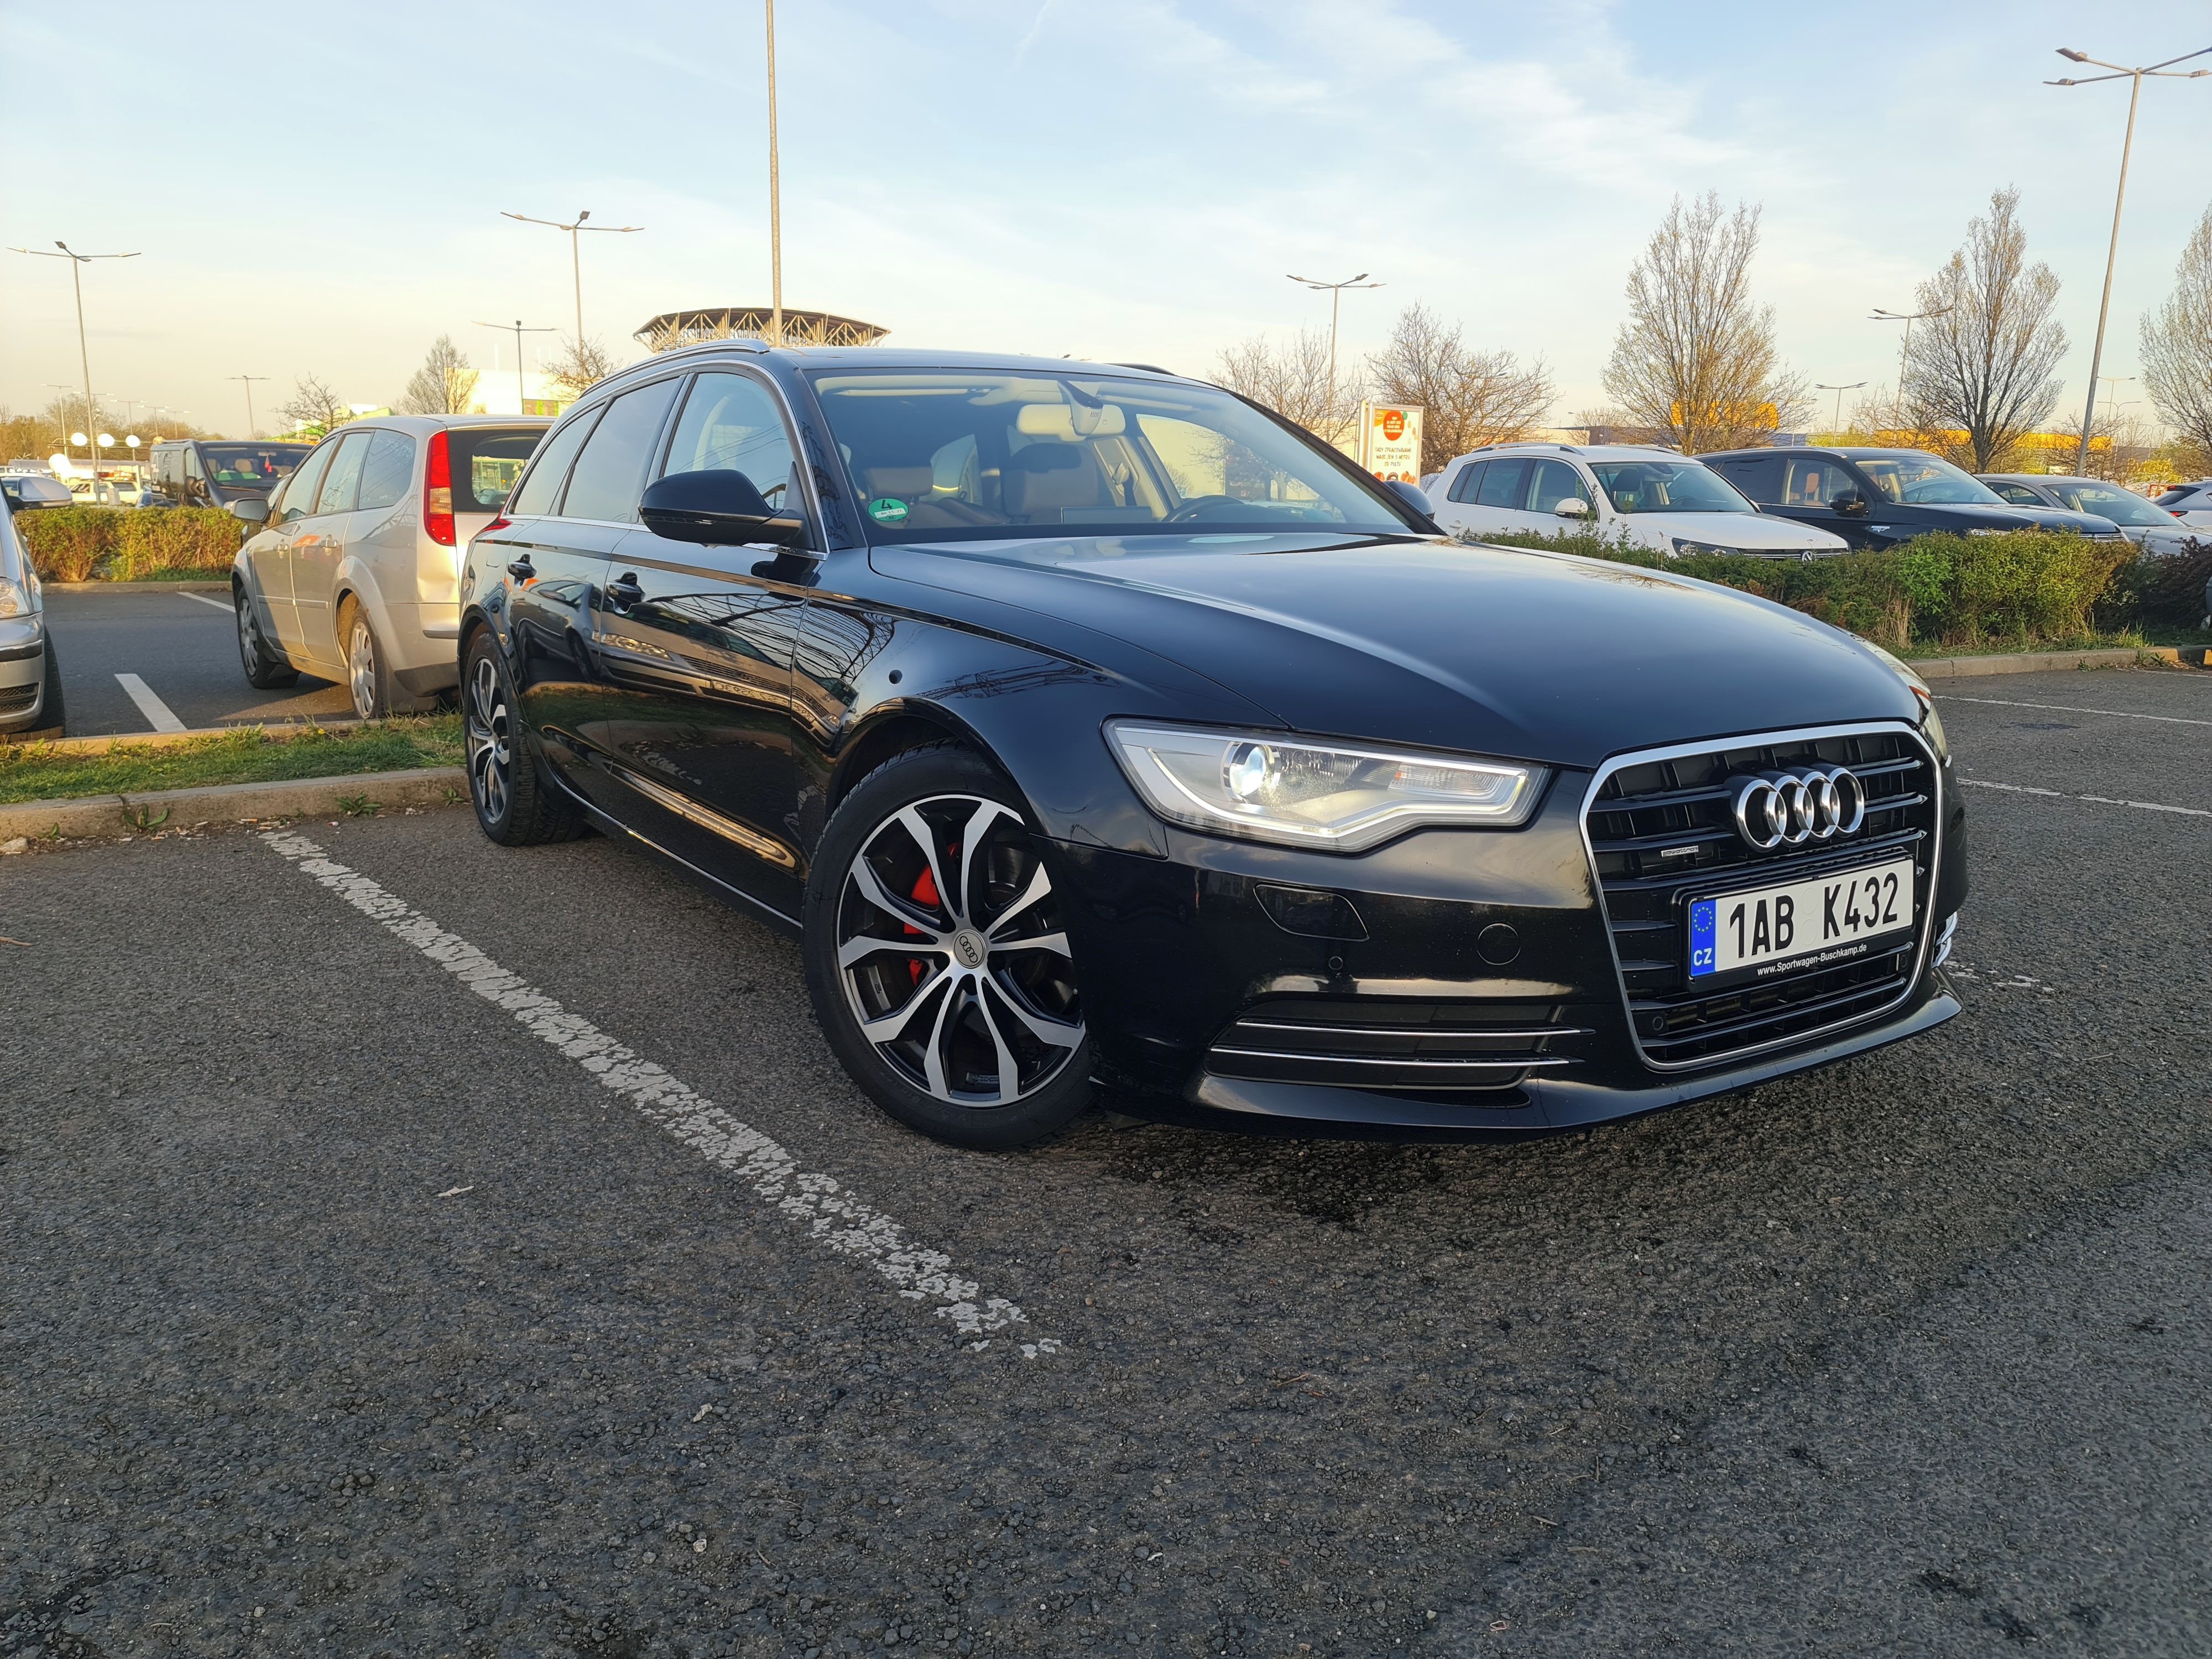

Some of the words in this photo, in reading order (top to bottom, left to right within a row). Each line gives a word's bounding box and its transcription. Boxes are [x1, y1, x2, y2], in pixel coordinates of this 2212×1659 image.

[881, 499, 893, 509] 4
[1729, 894, 1794, 959] 1AB
[1823, 872, 1899, 940] K432
[1693, 947, 1712, 967] CZ
[1757, 942, 1867, 976] www.Sportwagen-Buschkamp.de
